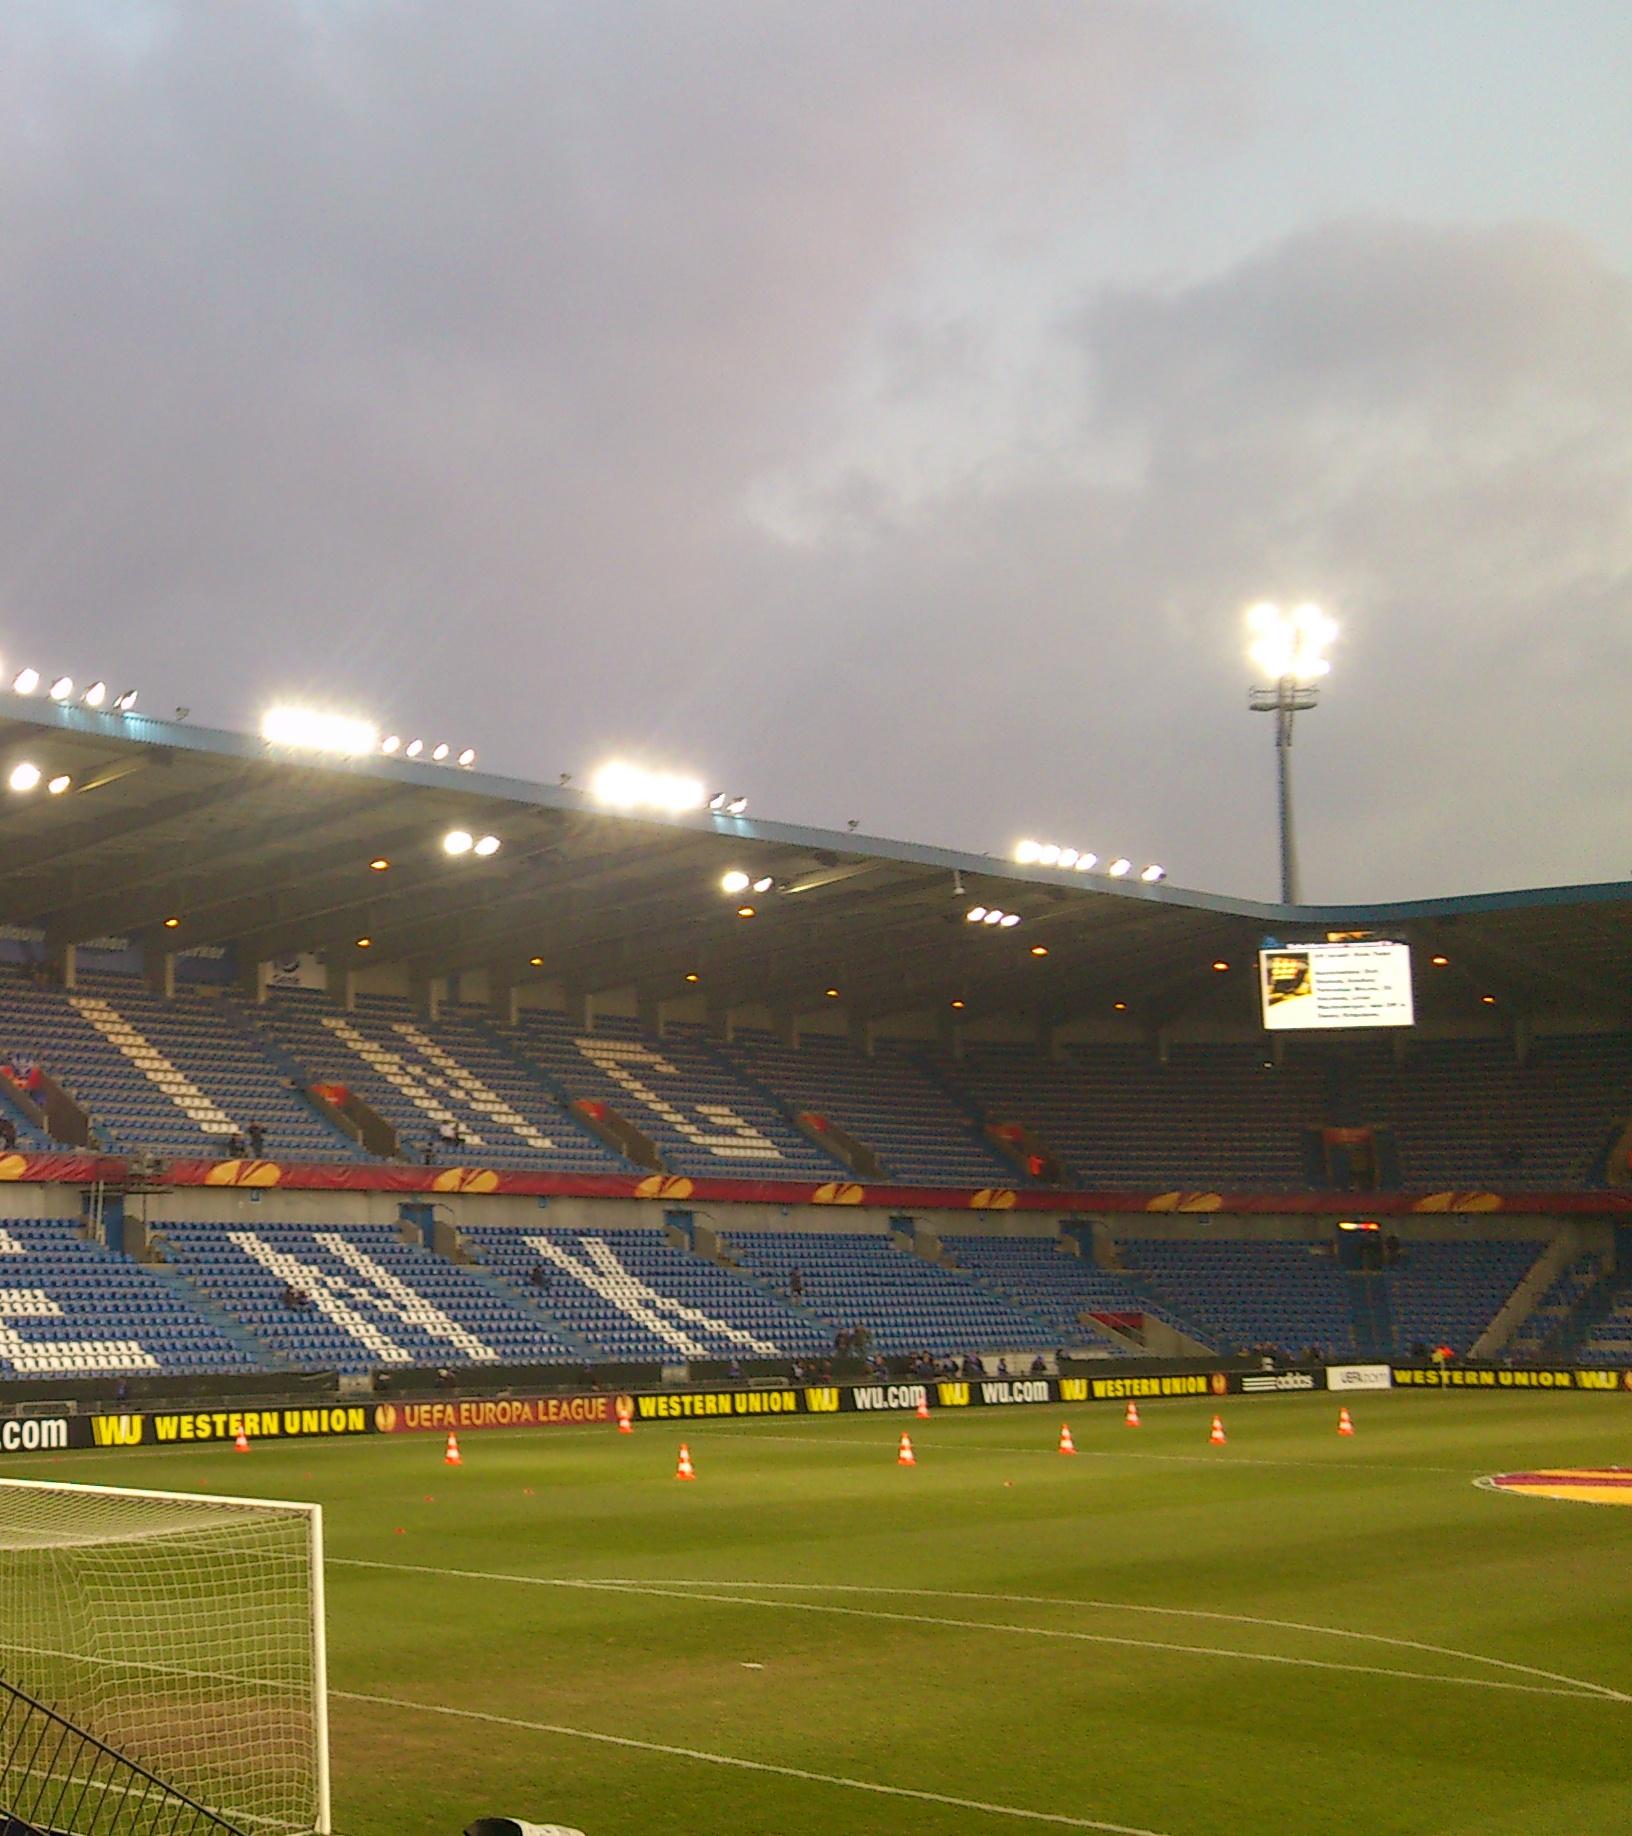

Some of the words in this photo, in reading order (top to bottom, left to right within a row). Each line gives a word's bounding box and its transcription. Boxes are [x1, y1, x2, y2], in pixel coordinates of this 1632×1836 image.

[1059, 1377, 1088, 1400] WU
[1092, 1376, 1160, 1399] WESTERN
[1162, 1374, 1208, 1396] UNION
[1391, 1369, 1495, 1385] WESTERN
[1498, 1370, 1571, 1387] UNION
[1574, 1370, 1618, 1389] WU
[637, 1393, 733, 1418] WESTERN
[734, 1390, 797, 1414] UNION
[804, 1387, 841, 1412] WU
[937, 1382, 970, 1406] WU
[154, 1411, 280, 1440] WESTERN
[283, 1408, 366, 1434] UNION
[404, 1403, 457, 1428] UEFA
[459, 1400, 535, 1426] EUROPA
[537, 1397, 608, 1422] LEAGUE
[90, 1414, 144, 1446] WU
